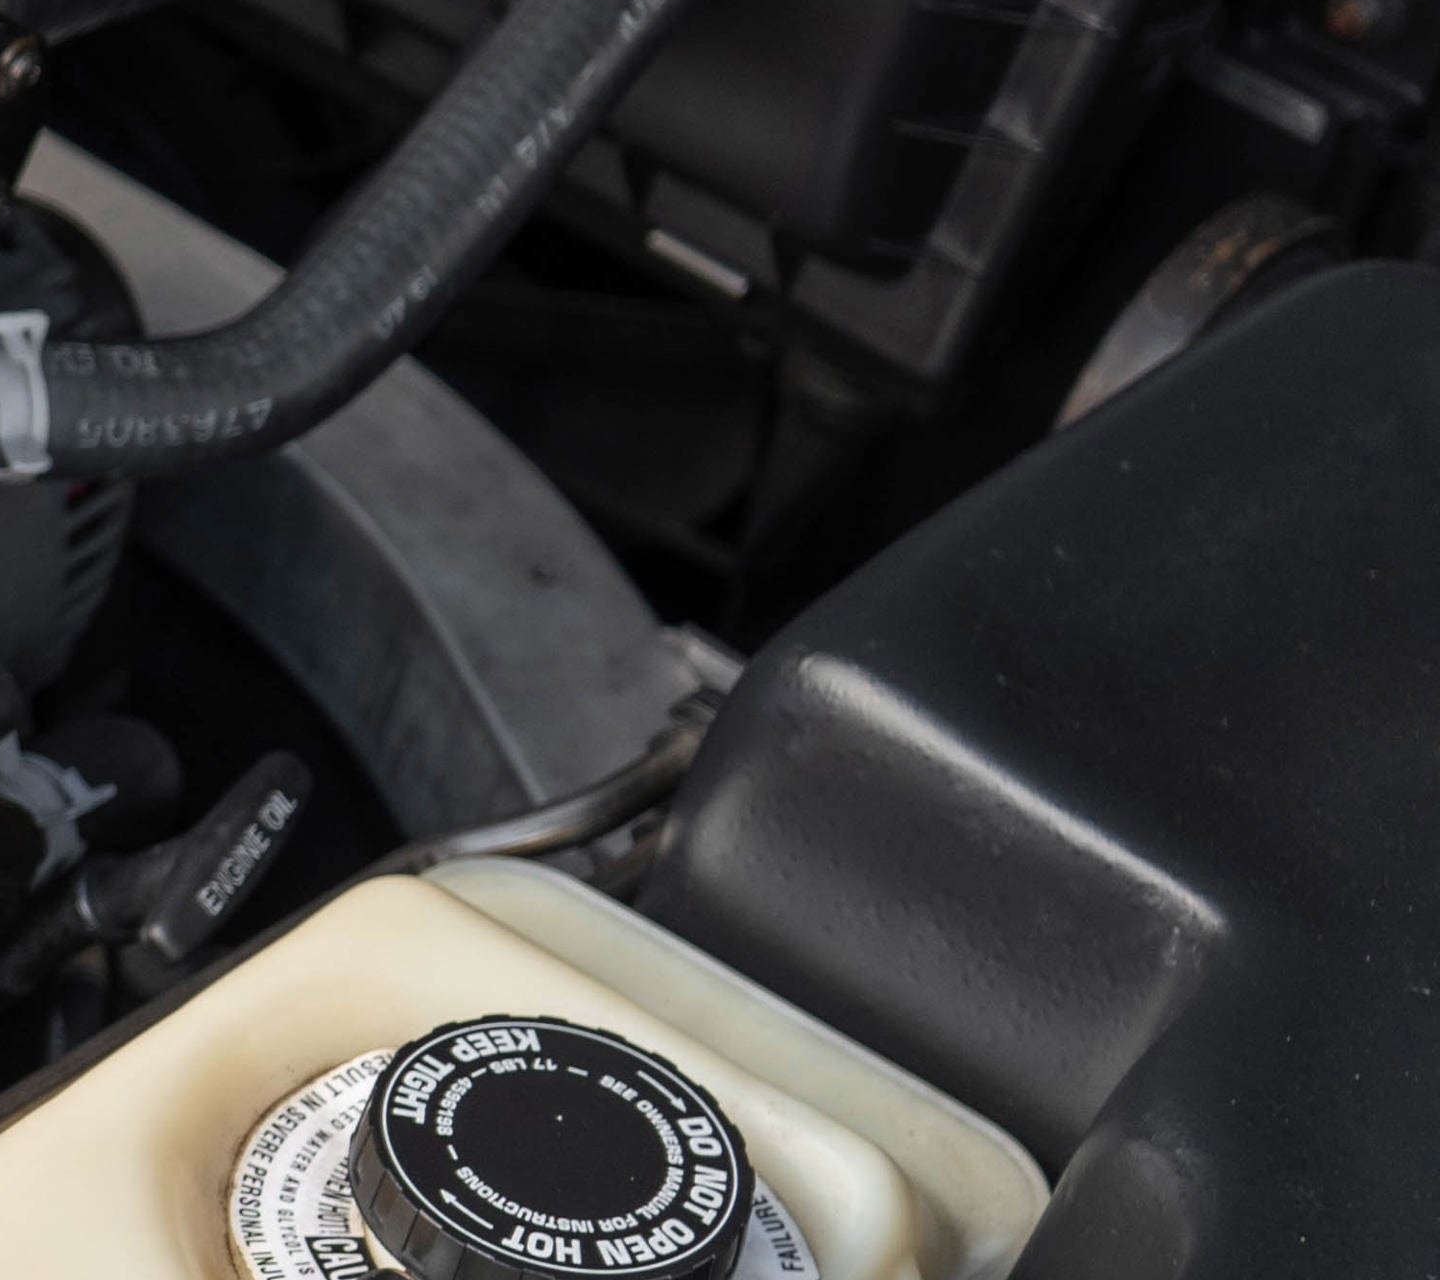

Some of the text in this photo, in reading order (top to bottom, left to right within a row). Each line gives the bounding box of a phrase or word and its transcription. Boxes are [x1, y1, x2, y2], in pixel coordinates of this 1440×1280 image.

[196, 789, 299, 917] ENGINE OIL
[392, 1028, 542, 1125] KEEP TIGHT
[488, 1057, 558, 1074] 17 LBS
[300, 1091, 327, 1111] IN
[251, 1106, 307, 1163] SEVERE
[290, 1132, 333, 1172] WATER
[455, 1075, 684, 1233] SEE OWNERS MANUAL FOR INSTRUCTIONS
[238, 1163, 268, 1247] PERSONAL
[279, 1175, 300, 1203] AND
[500, 1115, 728, 1267] DO NOT OPEN HOT
[277, 1209, 302, 1256] GLYCOL
[753, 1195, 805, 1272] FAILURE
[298, 1261, 315, 1277] IS
